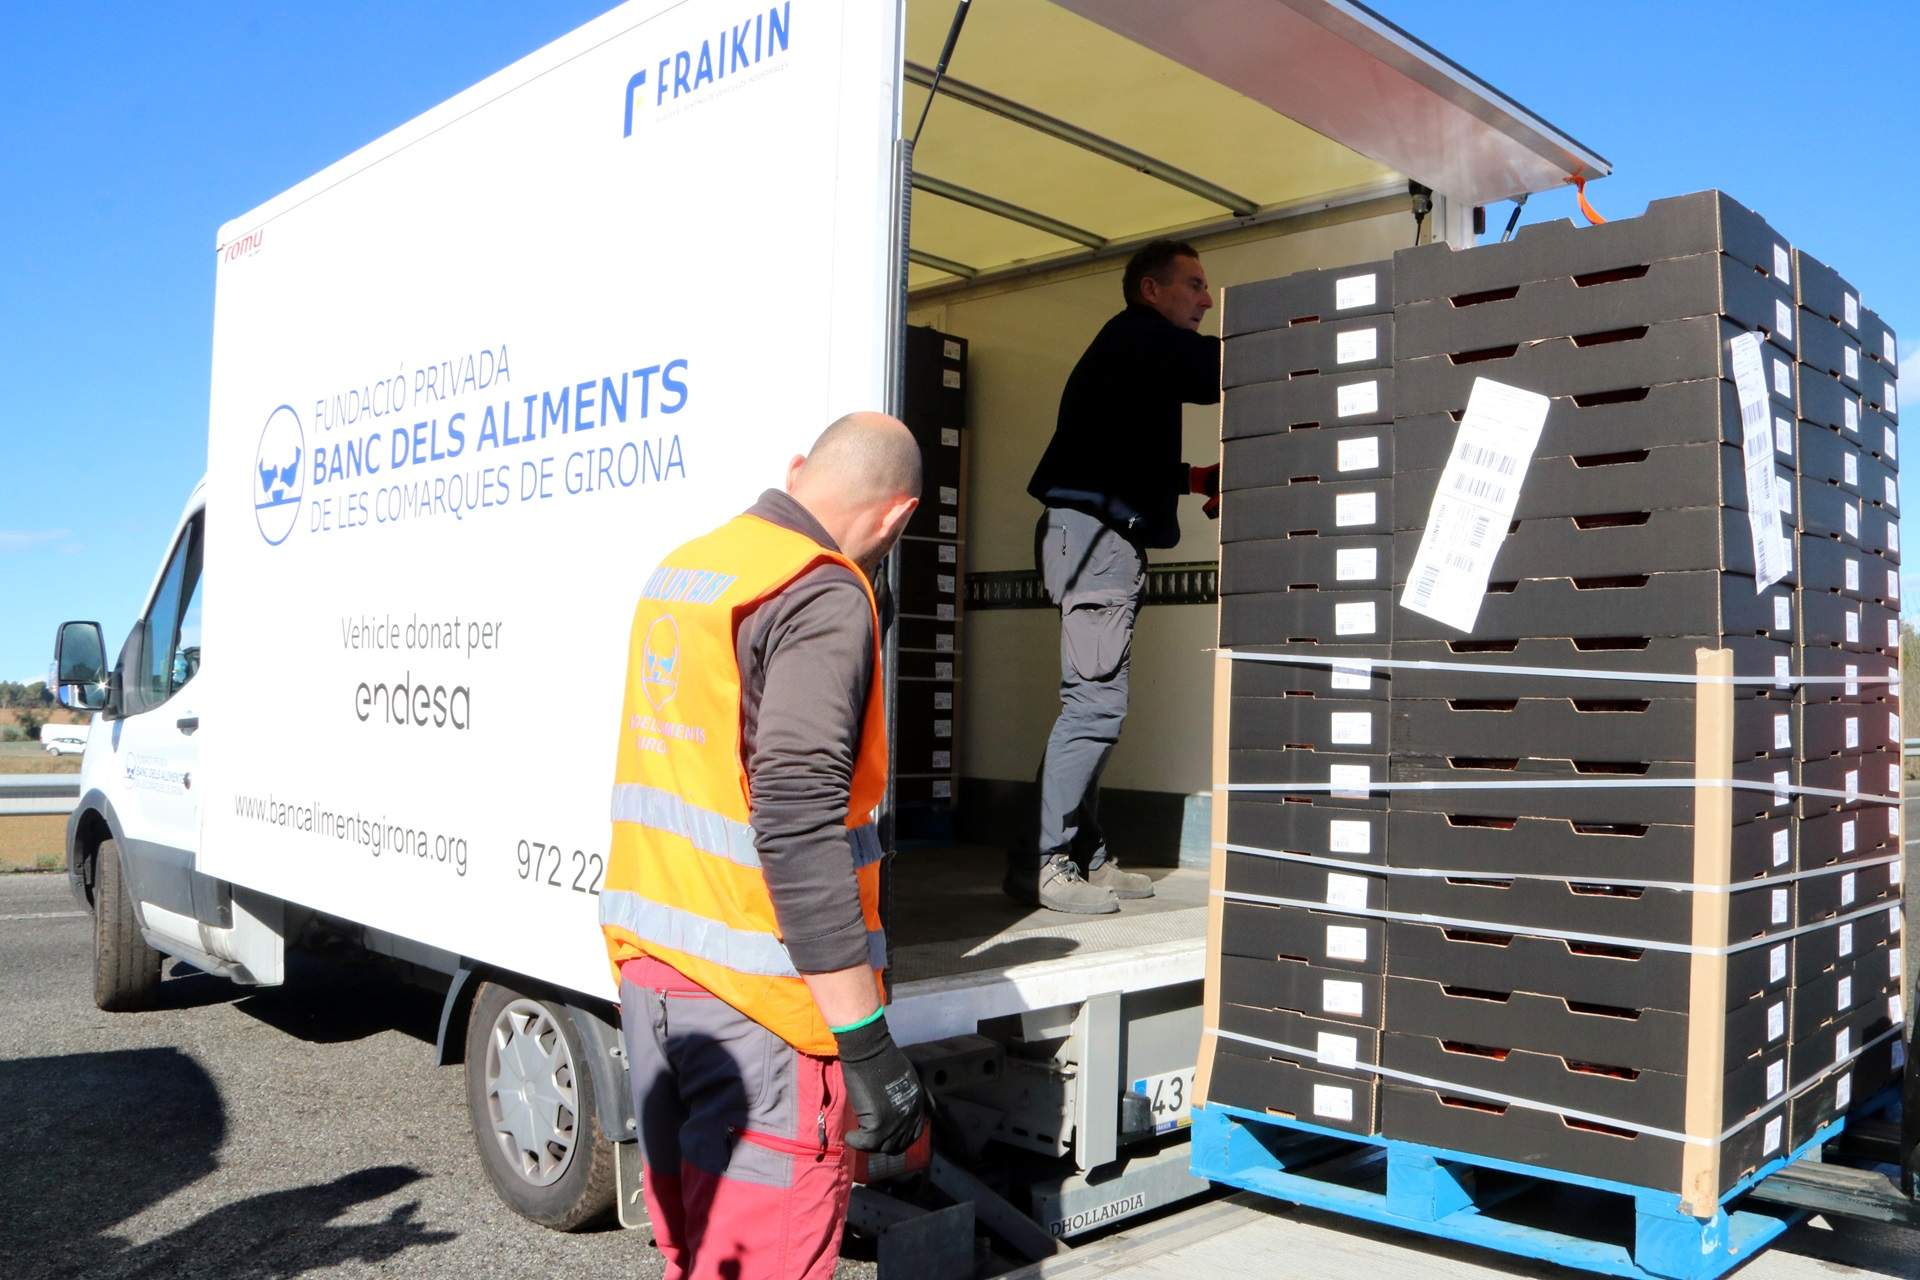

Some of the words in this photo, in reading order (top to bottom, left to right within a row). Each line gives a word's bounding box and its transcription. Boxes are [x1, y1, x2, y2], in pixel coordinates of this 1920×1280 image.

[657, 1, 790, 107] FRAIKIN
[313, 437, 382, 485] BANC
[391, 412, 466, 469] DELS
[477, 359, 688, 452] ALIMENTS
[315, 361, 406, 433] FUNDACIÓ
[414, 344, 510, 407] PRIVADA
[311, 498, 332, 533] DE
[338, 491, 369, 529] LES
[376, 465, 510, 524] COMARQUES
[521, 457, 555, 501] DE
[565, 435, 686, 494] GIRONA
[341, 613, 400, 650] Vehicle
[406, 613, 461, 650] donat
[468, 621, 503, 659] per
[355, 670, 471, 731] endesa
[234, 793, 468, 877] www.bancalimentsgirona.org
[517, 840, 562, 888] 972
[571, 850, 605, 897] 22
[1151, 1075, 1195, 1116] 43
[1051, 1194, 1145, 1238] DHOLLANDIA
